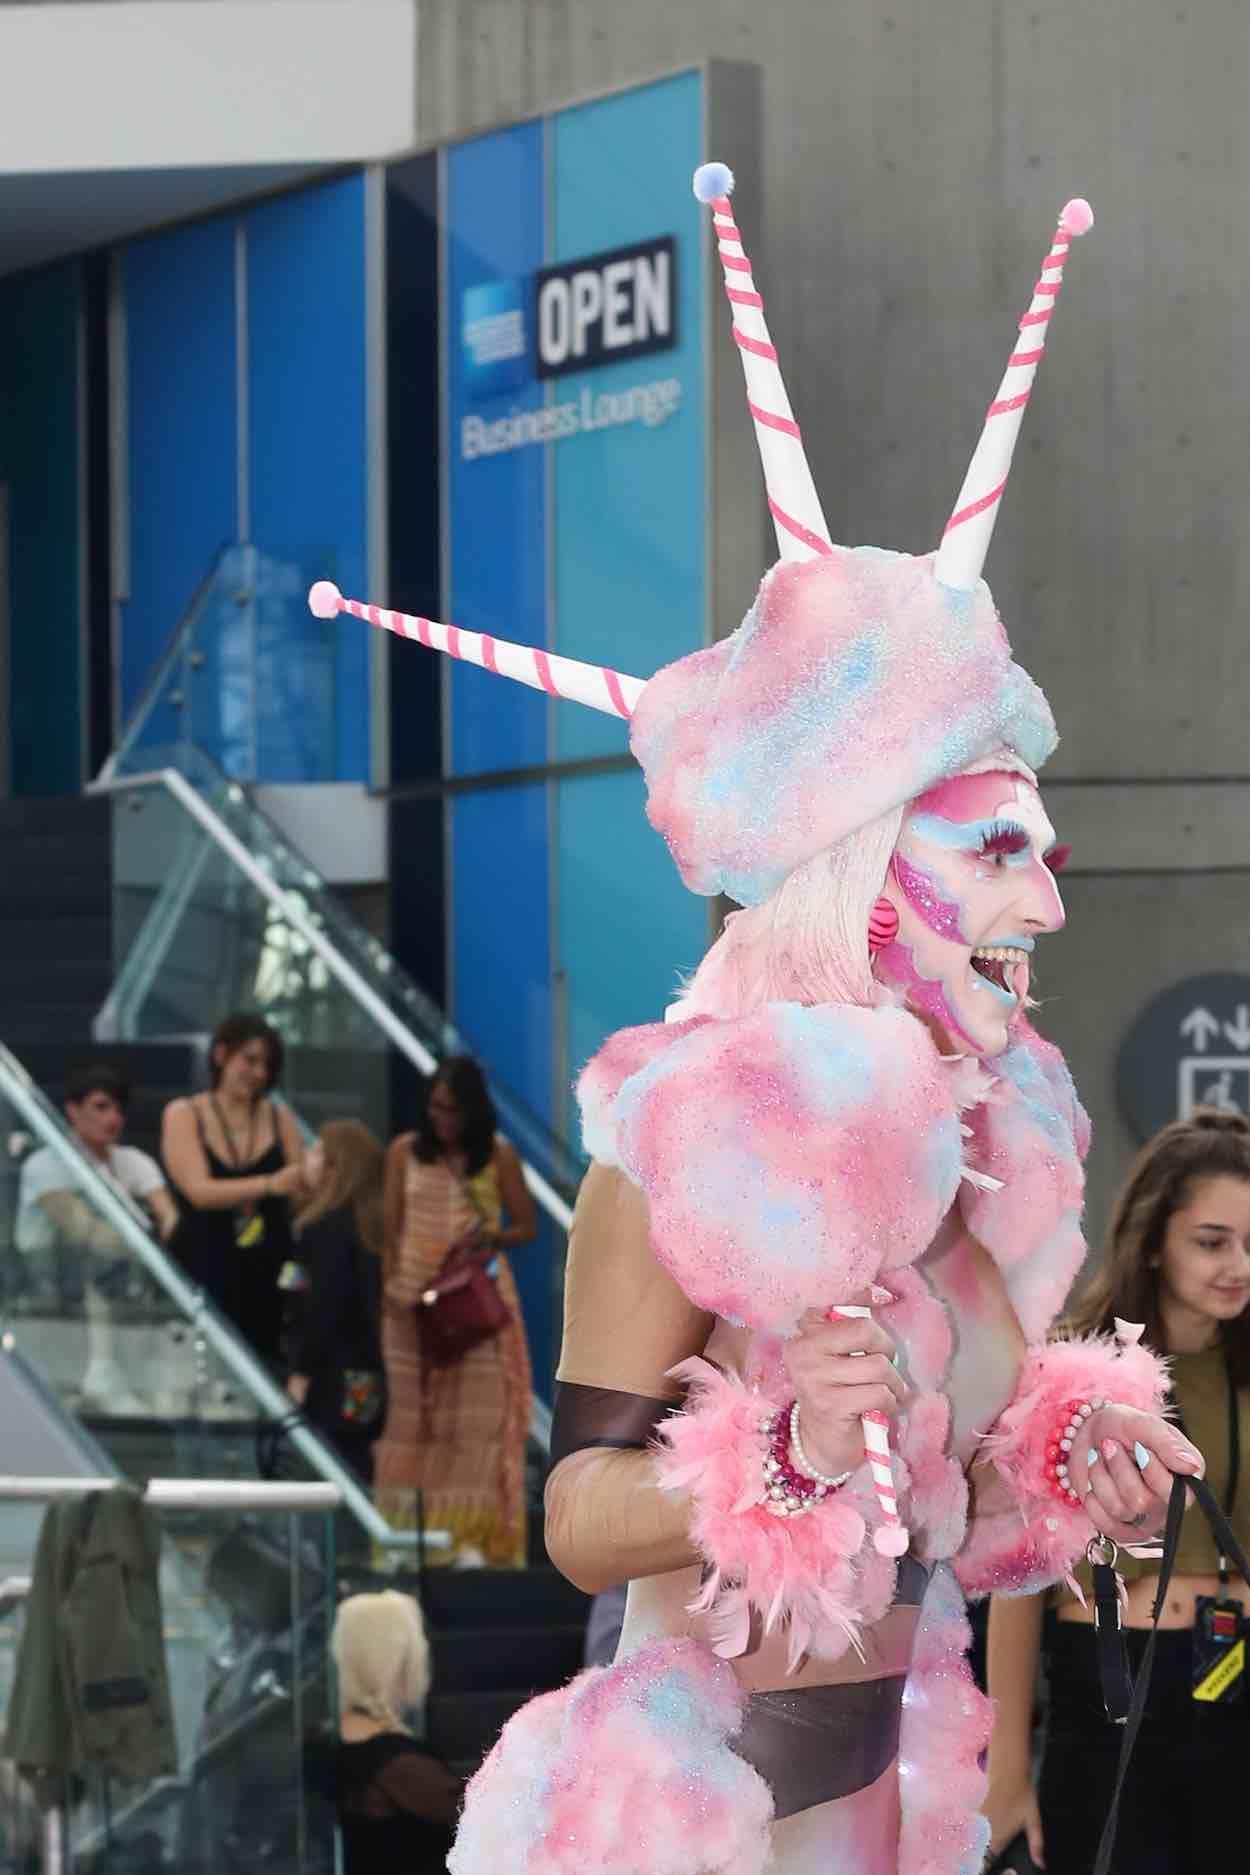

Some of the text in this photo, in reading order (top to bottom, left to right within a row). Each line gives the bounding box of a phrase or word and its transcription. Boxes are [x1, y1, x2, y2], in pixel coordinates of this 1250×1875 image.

[539, 250, 669, 365] OPEN
[461, 379, 682, 460] Business Lounge
